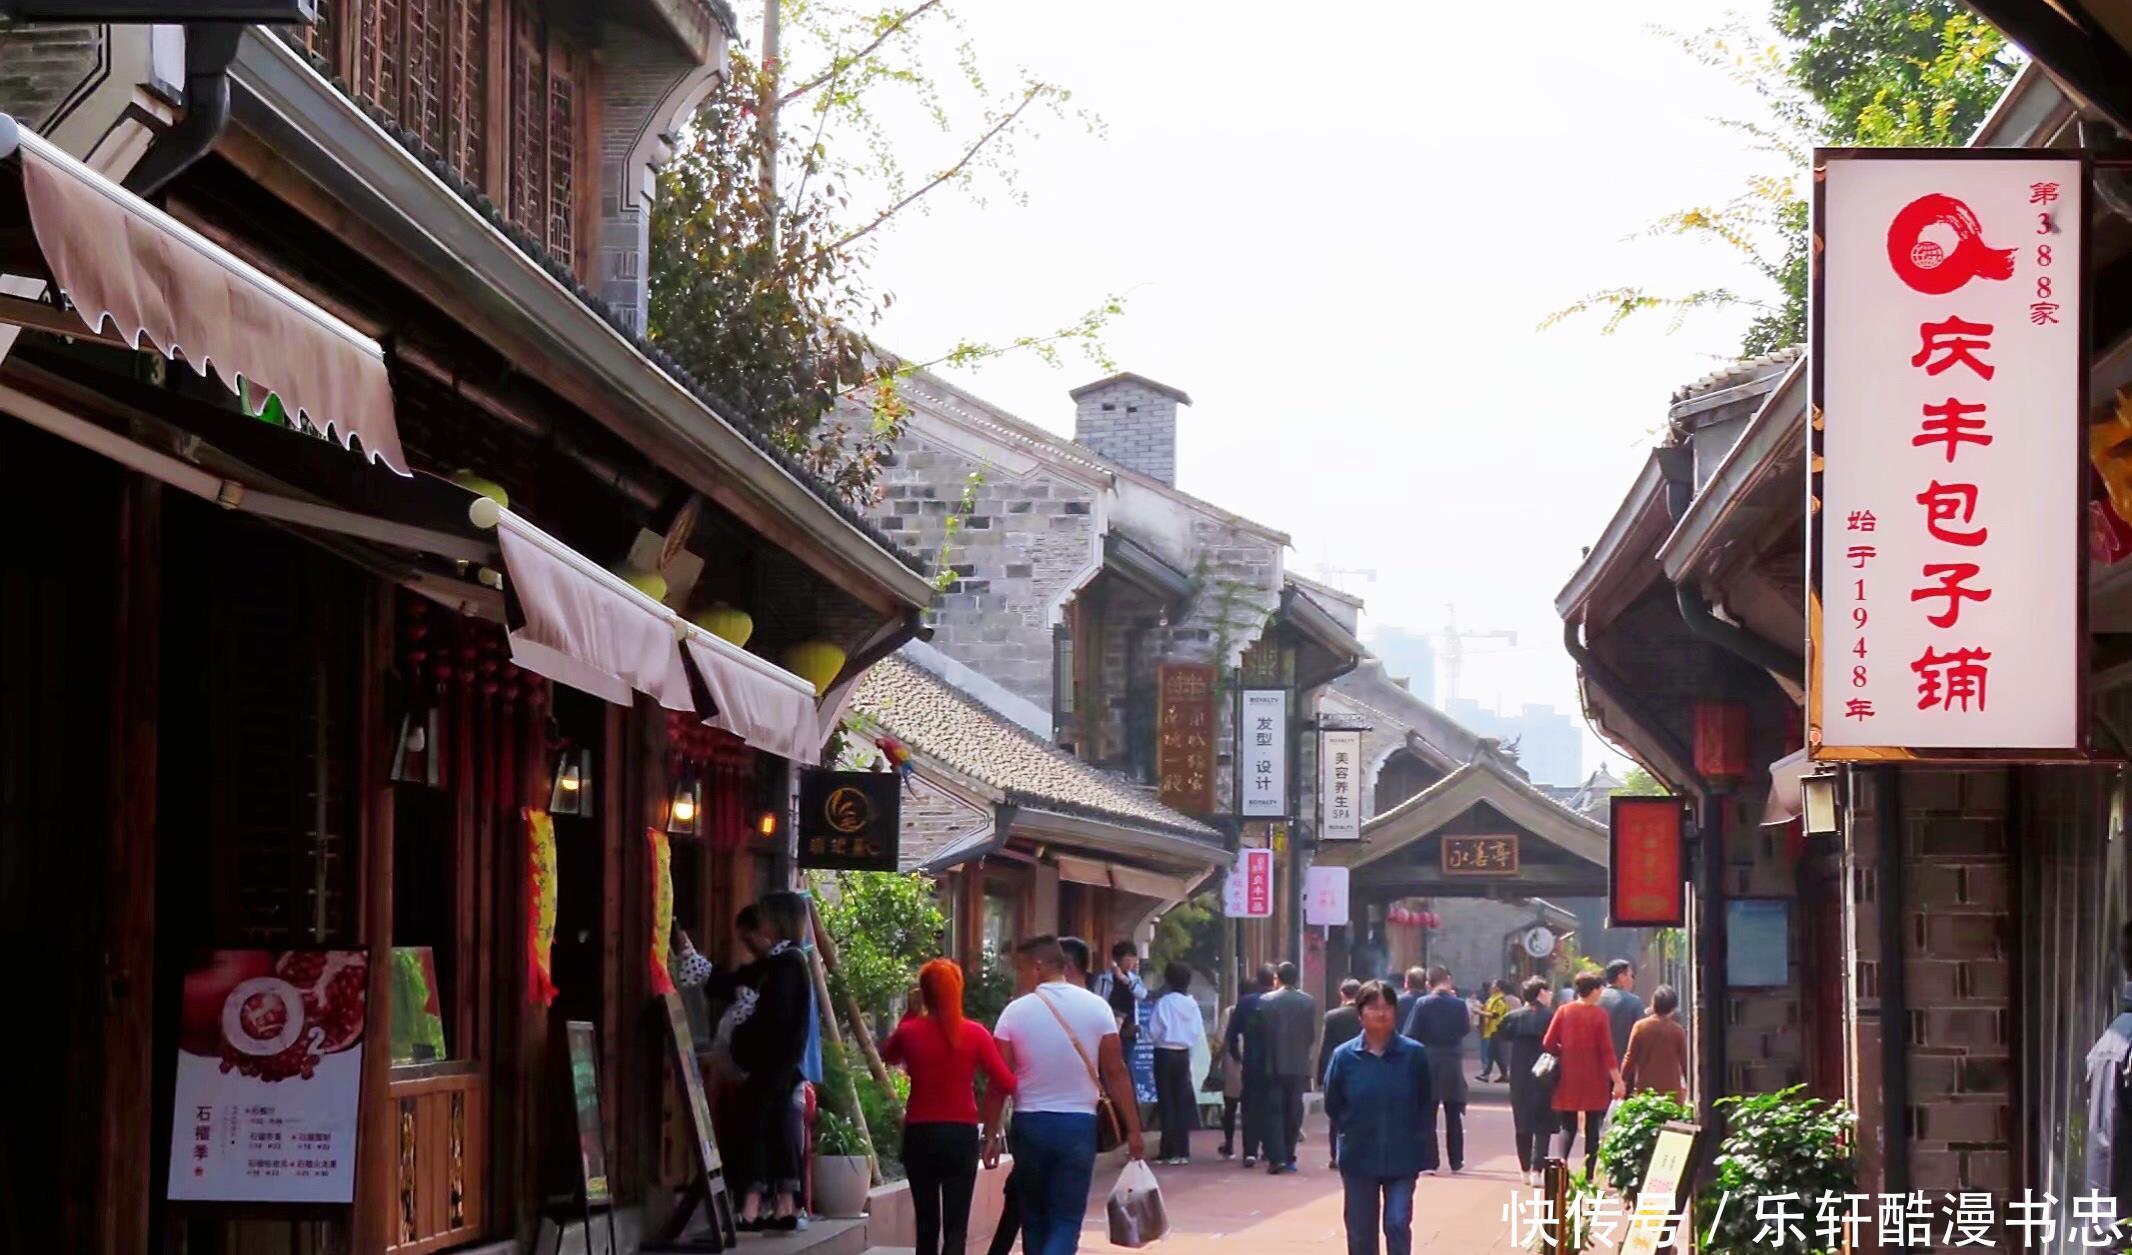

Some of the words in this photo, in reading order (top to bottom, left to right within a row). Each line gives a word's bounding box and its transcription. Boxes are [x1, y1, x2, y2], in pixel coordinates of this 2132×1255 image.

[2028, 181, 2060, 325] 第388家
[1910, 314, 1996, 713] 庆丰包子铺
[1845, 510, 1877, 722] 始于1948年
[1334, 752, 1349, 809] 美容养生
